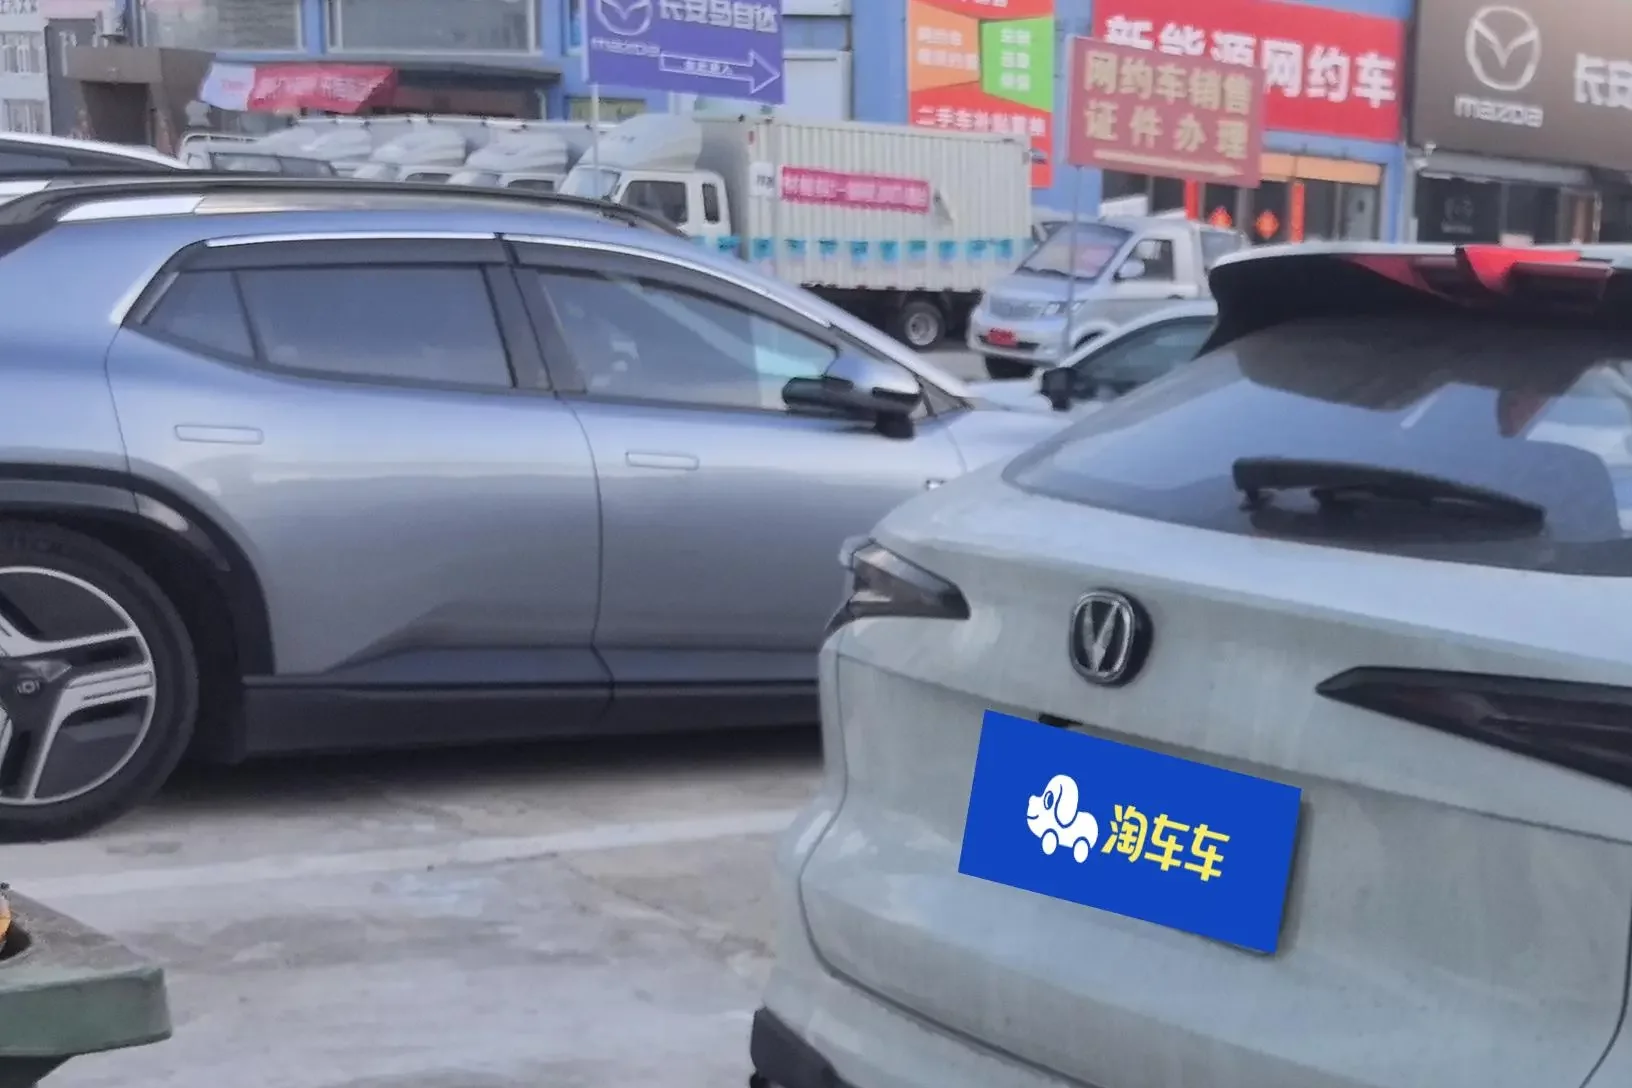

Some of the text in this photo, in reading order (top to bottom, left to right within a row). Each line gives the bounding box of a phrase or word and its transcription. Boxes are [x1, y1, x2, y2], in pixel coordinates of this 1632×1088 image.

[1084, 49, 1252, 115] 网约车销售
[1454, 94, 1544, 128] mazda
[1084, 99, 1248, 159] 证件办理
